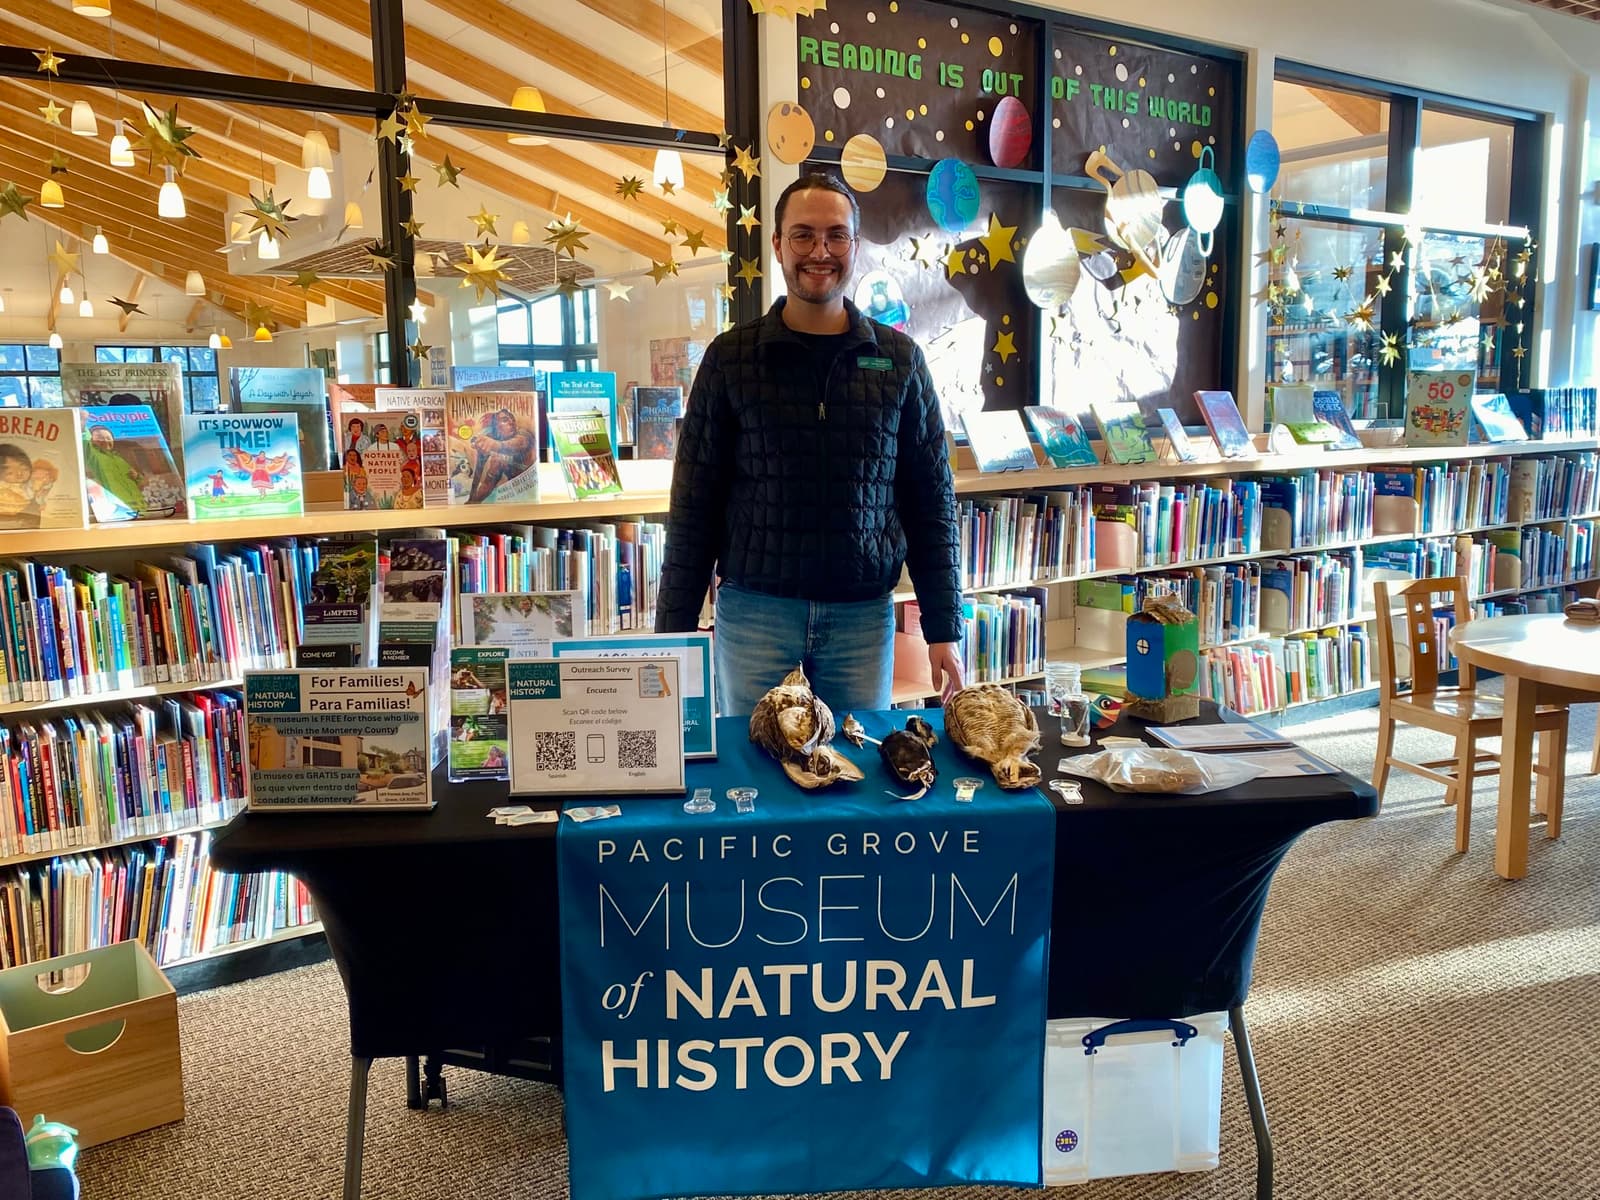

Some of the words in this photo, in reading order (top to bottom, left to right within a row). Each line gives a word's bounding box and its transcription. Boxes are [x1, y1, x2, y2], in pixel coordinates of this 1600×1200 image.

[800, 36, 922, 80] READING
[940, 62, 964, 88] IS
[982, 69, 1024, 96] OUT
[1052, 76, 1080, 101] OF
[1090, 84, 1139, 114] THIS
[1149, 96, 1211, 127] WORLD
[257, 390, 273, 398] Day
[1428, 382, 1455, 400] 50
[387, 396, 411, 406] NATIVE
[88, 410, 150, 423] Saltypie
[0, 416, 60, 442] BREAD
[198, 420, 218, 430] IT'S
[222, 418, 283, 429] POWWOW
[216, 431, 271, 448] TIME!
[606, 666, 630, 674] Survey
[312, 676, 335, 688] For
[340, 675, 404, 687] Families!
[310, 699, 342, 710] Para
[346, 698, 410, 710] Familias!
[322, 727, 363, 736] Monterey
[365, 726, 399, 735] County!
[254, 784, 266, 792] los
[598, 834, 792, 863] PACIFIC
[827, 830, 979, 855] GROVE
[600, 872, 1018, 950] MUSEUM
[602, 971, 654, 1020] of
[665, 959, 996, 1020] NATURAL
[602, 1031, 910, 1092] HISTORY
